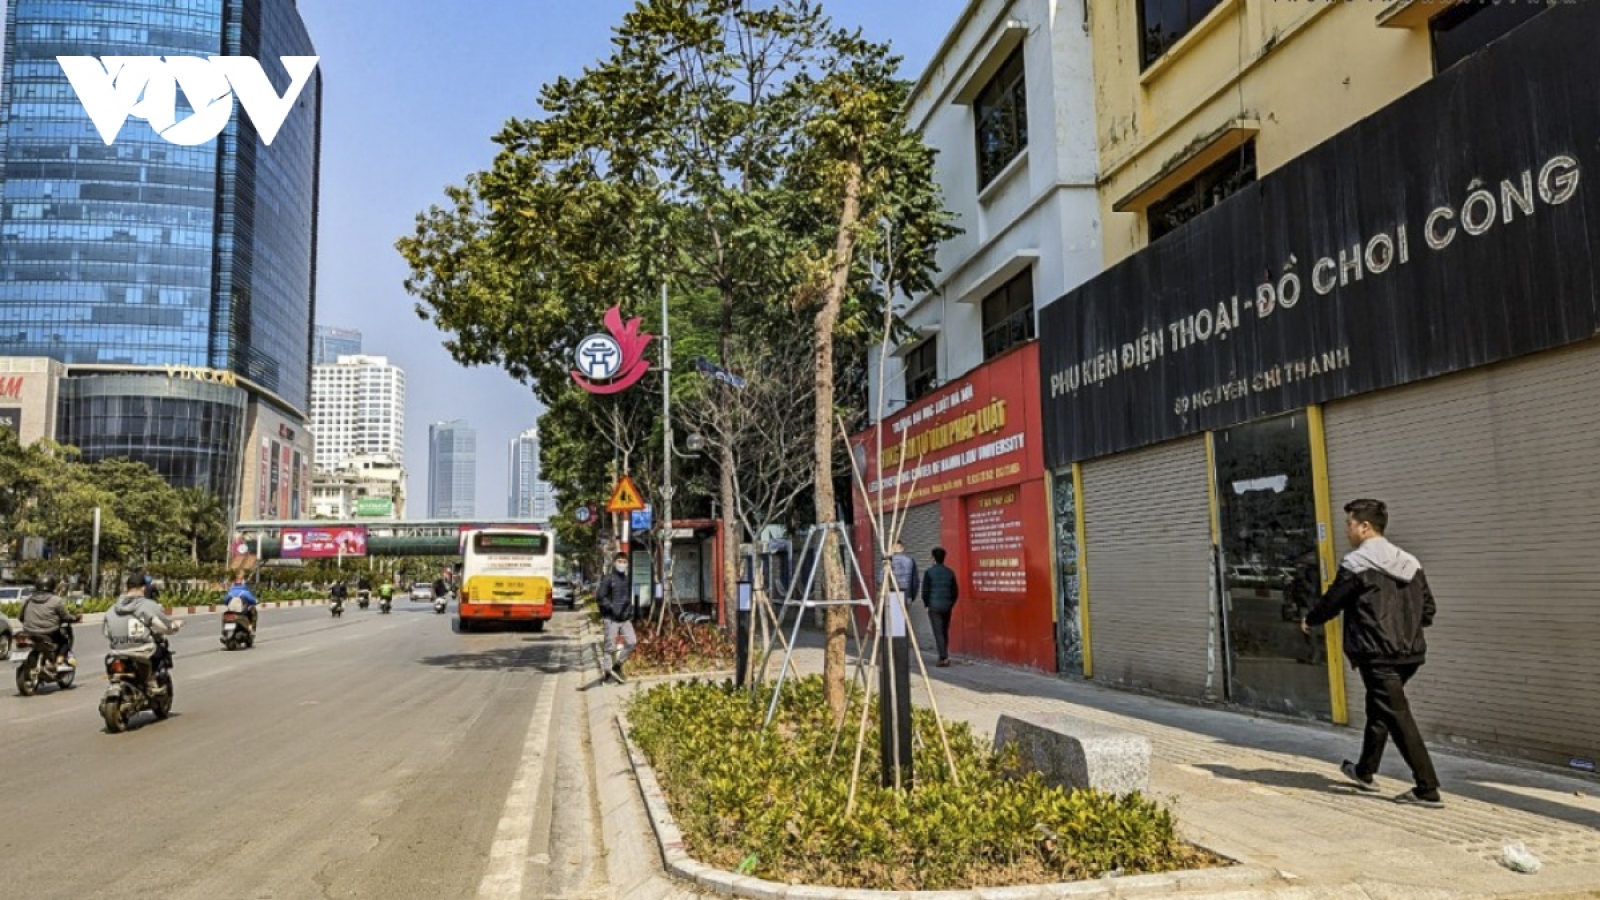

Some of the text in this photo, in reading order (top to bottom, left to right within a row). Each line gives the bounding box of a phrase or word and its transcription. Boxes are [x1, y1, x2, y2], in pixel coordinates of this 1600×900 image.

[1121, 326, 1164, 371] ĐIỆN
[1168, 295, 1240, 352] THOẠI
[1424, 155, 1580, 250] CÔNG
[164, 363, 237, 388] VINCOM
